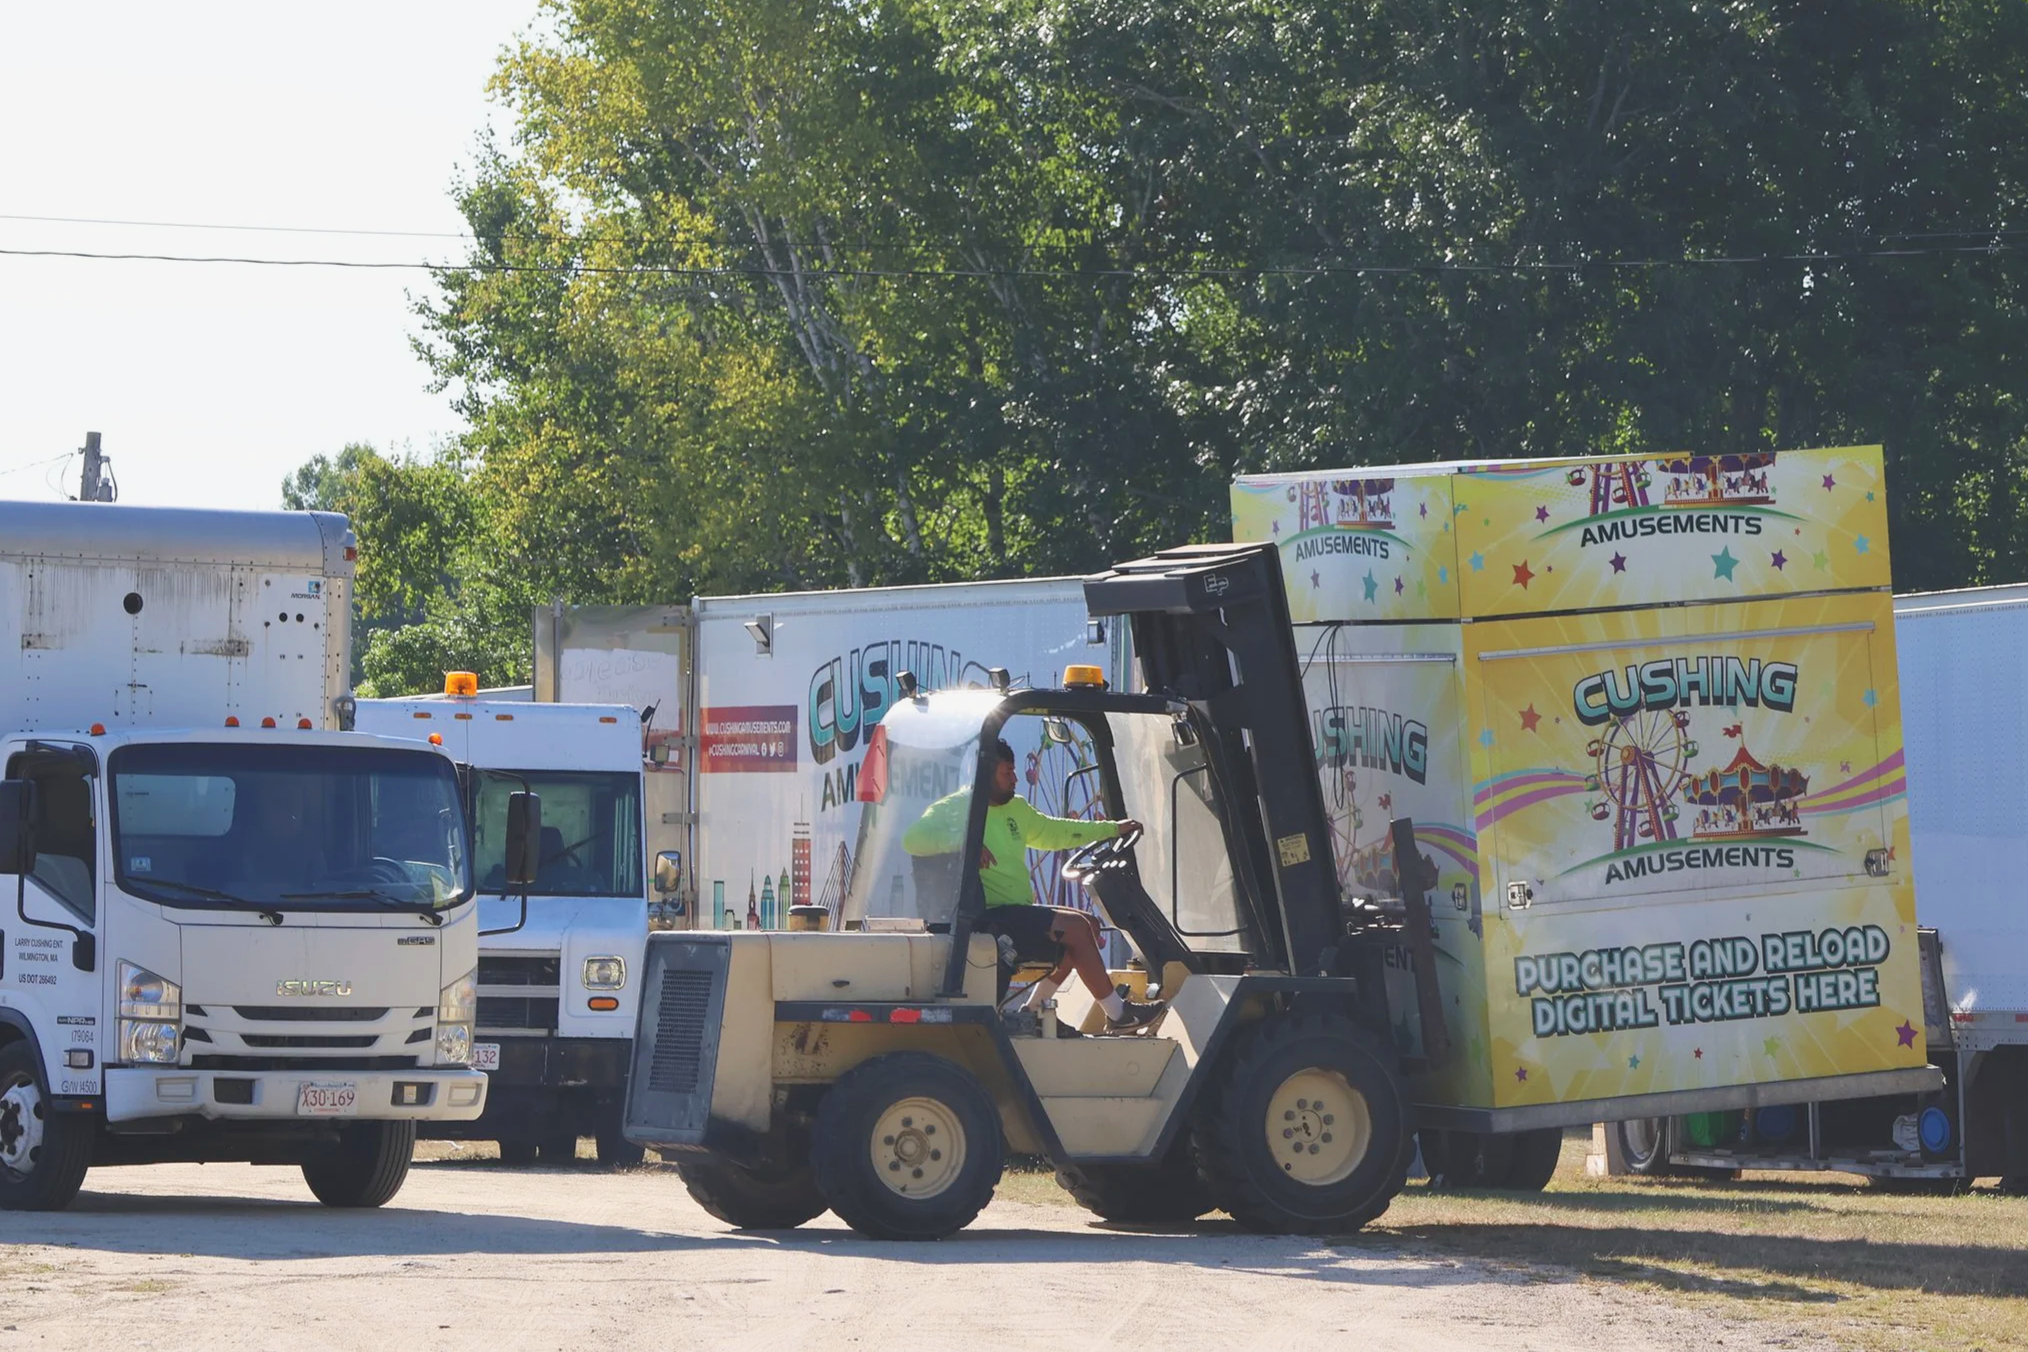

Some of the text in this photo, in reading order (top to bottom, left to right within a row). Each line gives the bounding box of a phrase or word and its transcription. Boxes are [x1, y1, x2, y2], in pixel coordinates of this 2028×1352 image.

[1580, 514, 1762, 548] AMUSEMENTS
[1295, 535, 1389, 562] AMUSEMENTS
[1573, 656, 1798, 726] CUSHING
[1604, 847, 1795, 885] AMUSEMENTS
[14, 937, 31, 947] LARRY
[31, 939, 53, 949] CUSHING
[50, 953, 58, 962] MA
[1514, 924, 1891, 997] PURCHASE AND RELOAD
[18, 973, 27, 984] US
[27, 974, 39, 984] DOT
[276, 980, 351, 997] ISUZU
[1531, 967, 1881, 1038] DIGITAL TICKETS HERE
